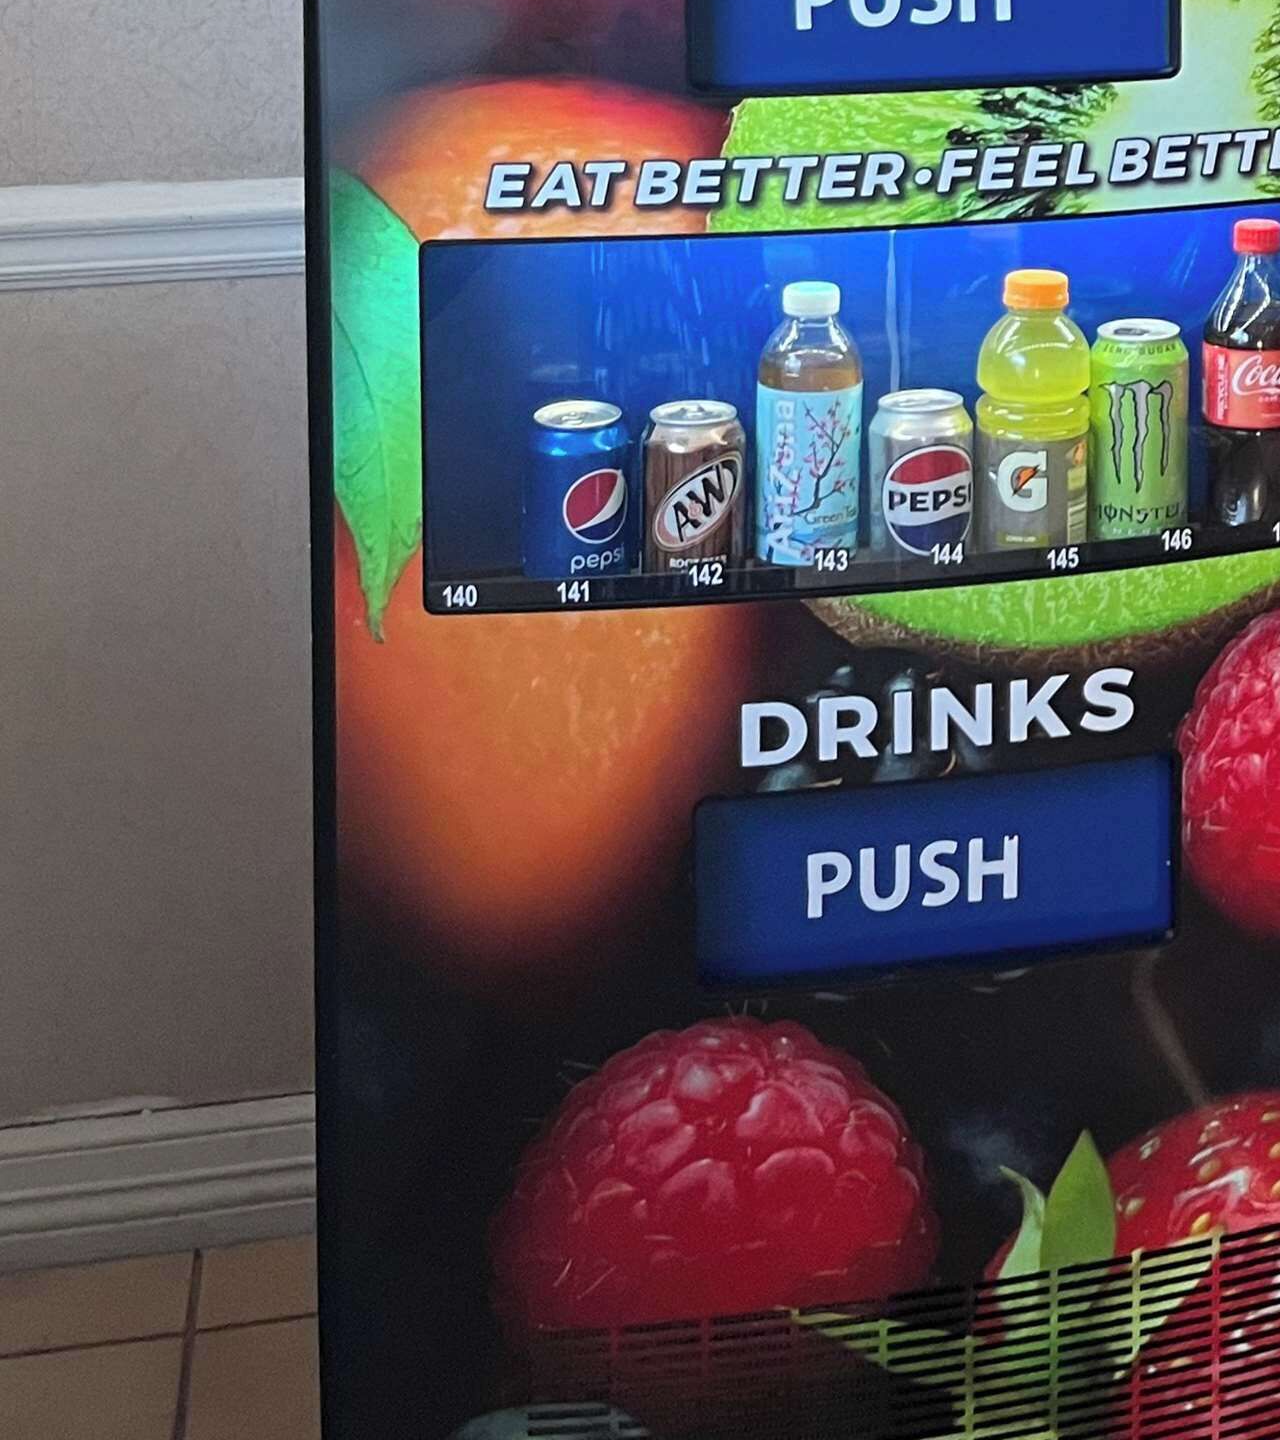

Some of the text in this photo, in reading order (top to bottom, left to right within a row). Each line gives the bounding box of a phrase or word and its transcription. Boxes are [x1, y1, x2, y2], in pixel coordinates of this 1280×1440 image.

[485, 162, 630, 210] EAT
[635, 152, 901, 206] BETTER
[940, 138, 1098, 195] FEEL
[1138, 342, 1179, 356] SUGAR
[998, 450, 1048, 512] G
[888, 482, 972, 512] PEPSI
[804, 508, 844, 525] Green
[1161, 528, 1193, 551] 146
[570, 542, 624, 574] pepsi
[815, 549, 848, 571] 143
[931, 543, 964, 565] 144
[1047, 548, 1079, 570] 145
[689, 563, 723, 586] 142
[442, 585, 478, 607] 140
[557, 580, 590, 603] 141
[741, 668, 1134, 767] DRINKS
[807, 835, 1018, 918] PUSH
